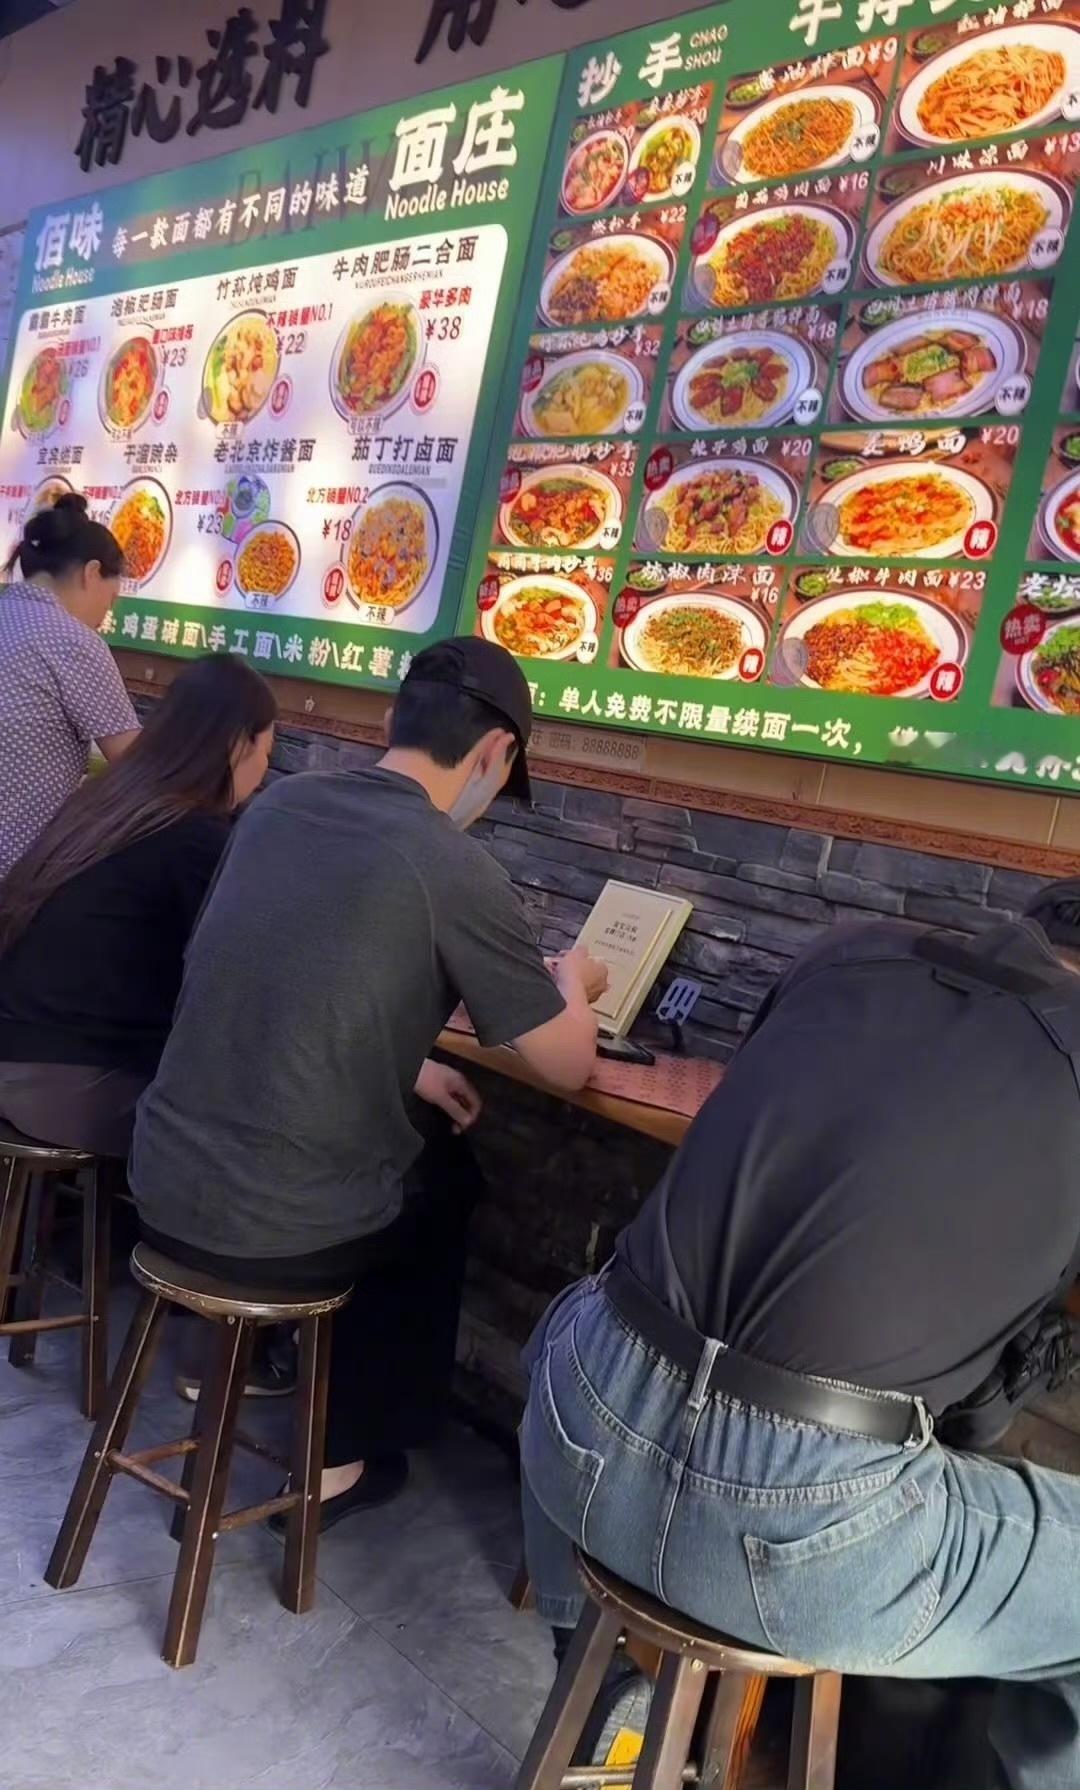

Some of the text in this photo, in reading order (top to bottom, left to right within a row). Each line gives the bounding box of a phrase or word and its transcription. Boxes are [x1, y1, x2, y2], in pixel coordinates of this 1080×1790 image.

[690, 24, 728, 49] CHAO
[684, 46, 723, 71] SHOU
[870, 37, 898, 66] ¥9
[577, 32, 685, 108] 抄手
[387, 85, 525, 191] 面庄
[839, 171, 870, 193] ¥16
[112, 164, 370, 258] 每一款面都有不同的味道
[385, 176, 508, 221] Noodle House
[660, 205, 688, 225] ¥22
[35, 202, 103, 271] 佰味
[332, 235, 479, 282] 牛肉肥肠二合面
[425, 316, 462, 341] ¥38
[808, 321, 838, 340] ¥18
[635, 339, 661, 357] ¥32
[780, 438, 813, 457] ¥20
[981, 425, 1020, 446] ¥20
[213, 437, 316, 463] 老北京炸酱面
[351, 437, 458, 464] 茄丁打卤面
[610, 461, 635, 477] ¥33
[197, 513, 223, 535] ¥23
[321, 518, 352, 543] ¥18
[948, 570, 987, 591] ¥23
[750, 586, 780, 604] ¥16
[366, 605, 387, 623] 不辣
